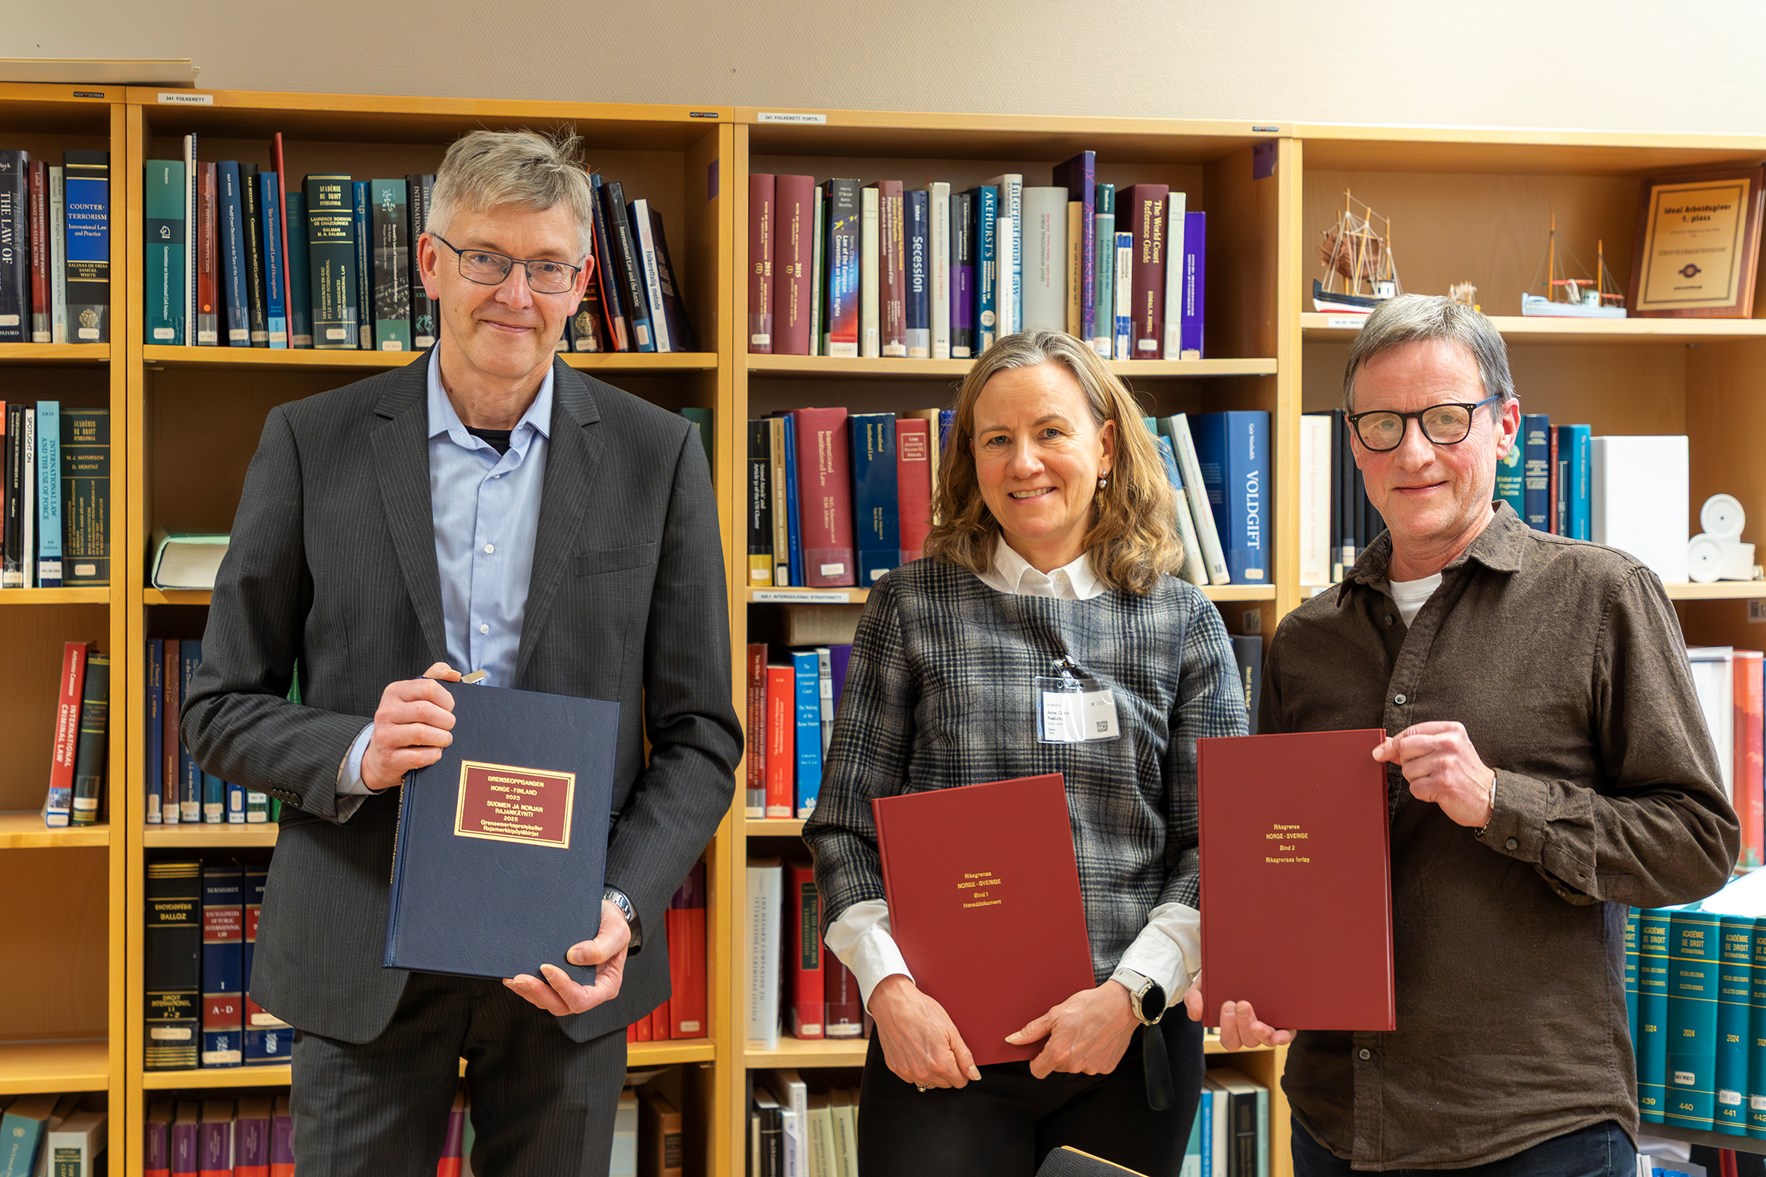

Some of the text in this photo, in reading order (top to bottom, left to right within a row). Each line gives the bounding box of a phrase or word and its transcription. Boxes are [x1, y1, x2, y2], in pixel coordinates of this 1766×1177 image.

[0, 191, 12, 264] THE LAW OF
[619, 226, 631, 259] International
[985, 192, 993, 257] AKEHURST'S
[1012, 182, 1021, 296] International Law
[1143, 200, 1151, 264] Reference Guide
[1153, 201, 1162, 264] The World Court
[646, 251, 660, 310] Folkerettslig metode
[912, 236, 924, 292] Secession
[27, 453, 32, 463] ON
[42, 484, 49, 495] OF
[1246, 470, 1260, 550] VOLDGIFT
[56, 704, 68, 762] CRIMINAL LAW
[64, 705, 76, 767] INTERNATIONAL
[487, 800, 511, 809] SUOMEN
[521, 804, 543, 812] NORJAN
[490, 785, 510, 793] NORGE
[514, 787, 537, 795] FINLAND
[1727, 1034, 1739, 1043] 2024
